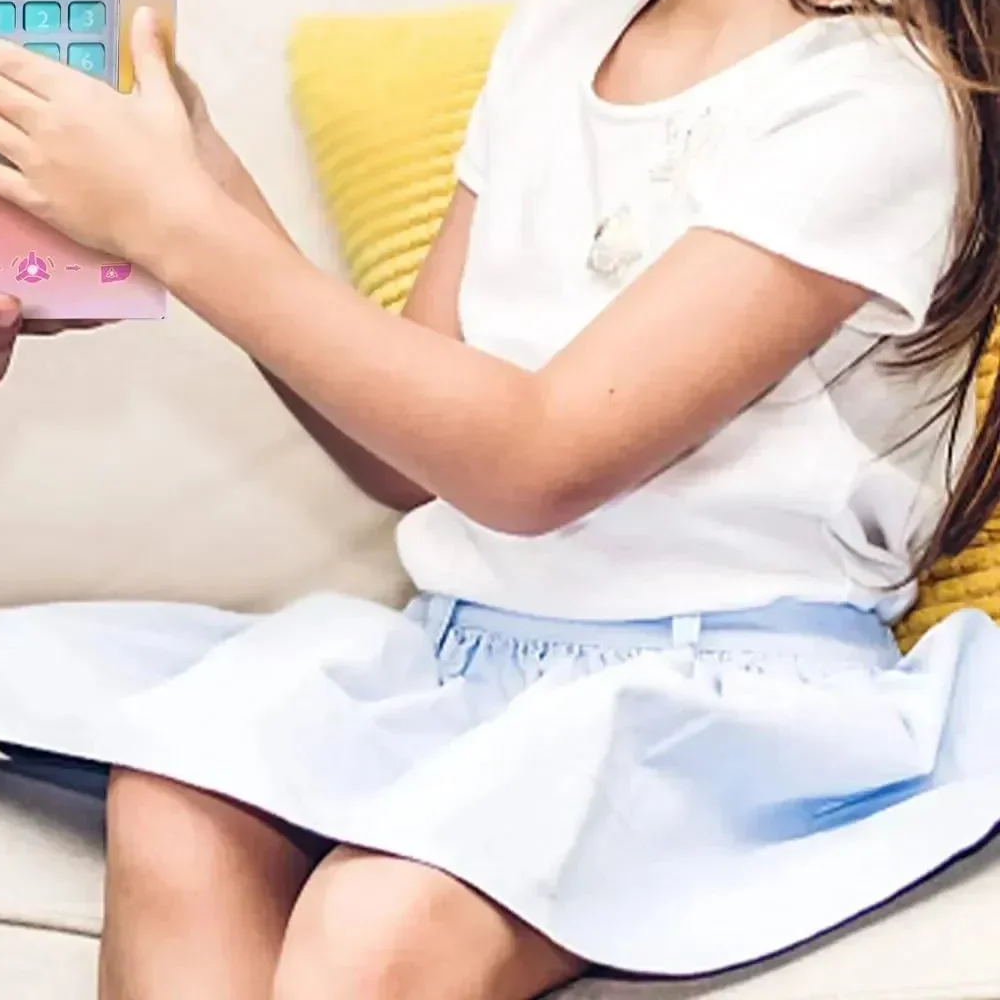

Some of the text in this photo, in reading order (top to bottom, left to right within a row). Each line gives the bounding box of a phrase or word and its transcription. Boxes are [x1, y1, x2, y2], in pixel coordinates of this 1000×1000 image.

[37, 10, 50, 28] 2
[83, 9, 95, 28] 3
[81, 51, 94, 71] 6
